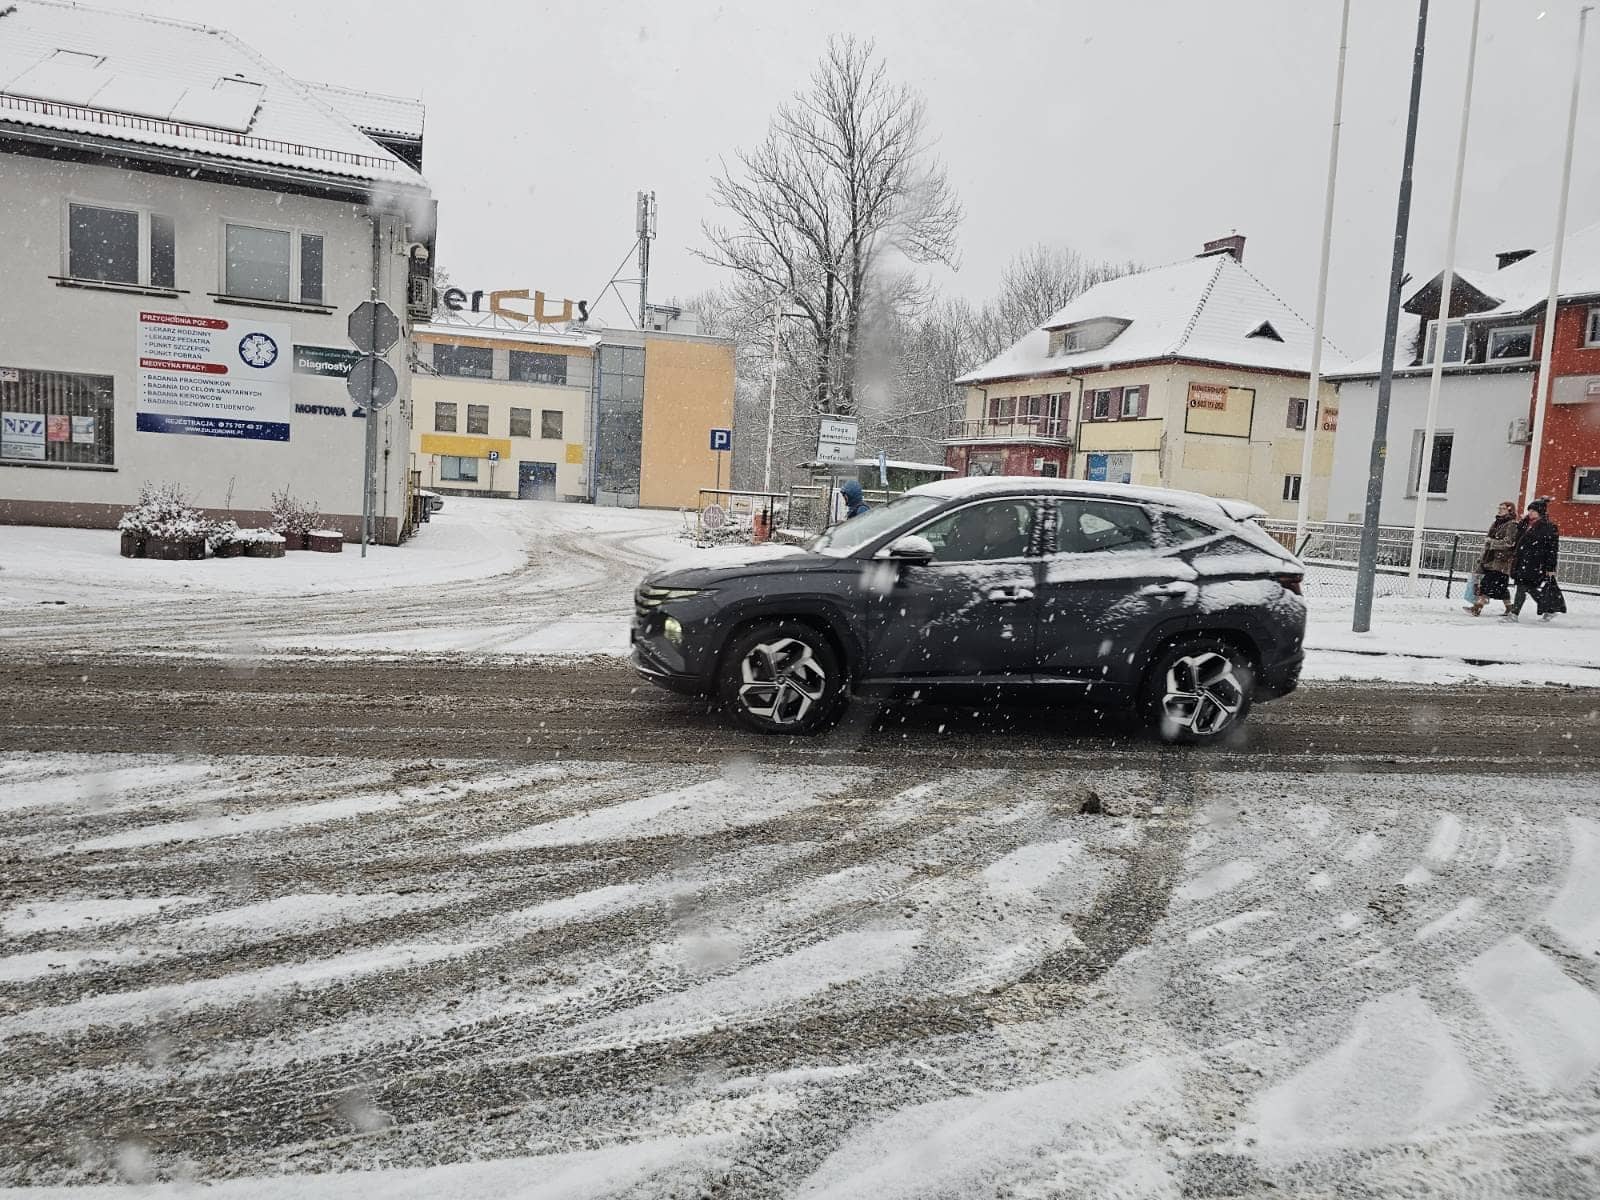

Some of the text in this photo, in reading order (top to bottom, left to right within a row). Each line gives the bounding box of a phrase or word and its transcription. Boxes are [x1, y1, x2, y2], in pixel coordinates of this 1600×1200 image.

[142, 313, 192, 325] PRZYCHODNIA
[149, 326, 211, 337] LEKARZ RODZINNY
[149, 334, 211, 345] LEKARZ PEDIATRA
[142, 359, 181, 369] MEDYCYNA
[299, 359, 353, 373] Diagnostyk
[147, 374, 178, 382] BADANIA
[147, 382, 178, 390] BADANIA
[190, 385, 215, 393] CELÓW
[217, 388, 262, 397] SANITARNYCH
[147, 390, 178, 398] BADANIA
[147, 398, 178, 406] BADANIA
[295, 403, 347, 417] MOSTOWA
[4, 418, 43, 435] NFZ
[715, 431, 727, 449] P
[490, 451, 498, 460] P
